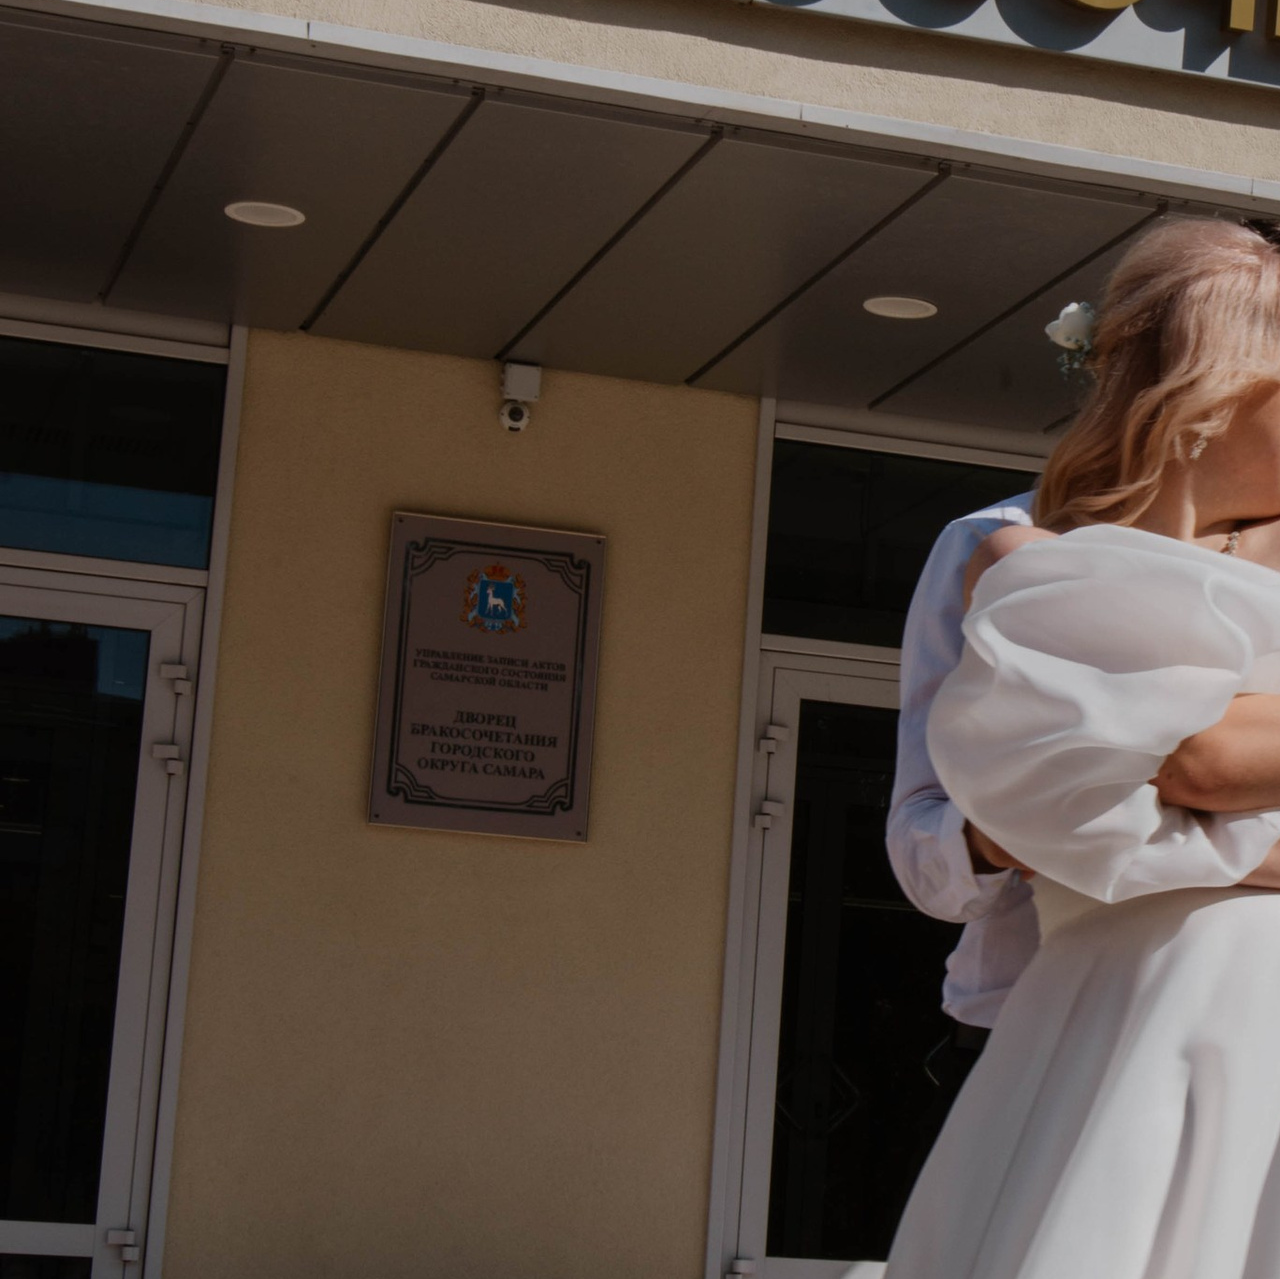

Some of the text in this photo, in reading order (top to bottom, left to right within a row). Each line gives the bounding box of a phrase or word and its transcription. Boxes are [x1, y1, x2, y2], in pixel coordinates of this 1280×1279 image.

[413, 658, 499, 676] ГРАЖДАНСКОГО
[415, 648, 484, 663] УПРАВЛЕНИЕ
[532, 660, 566, 672] АКТОВ
[430, 672, 549, 692] САМАРСКОЙ ОБЛАСТИ
[453, 710, 517, 730] ДВОРЕЦ
[410, 723, 559, 748] БРАКОСОЧЕТАНИЯ
[430, 741, 536, 763] ГОРОДСКОГО
[417, 757, 546, 780] ОКРУГА САМАРА
